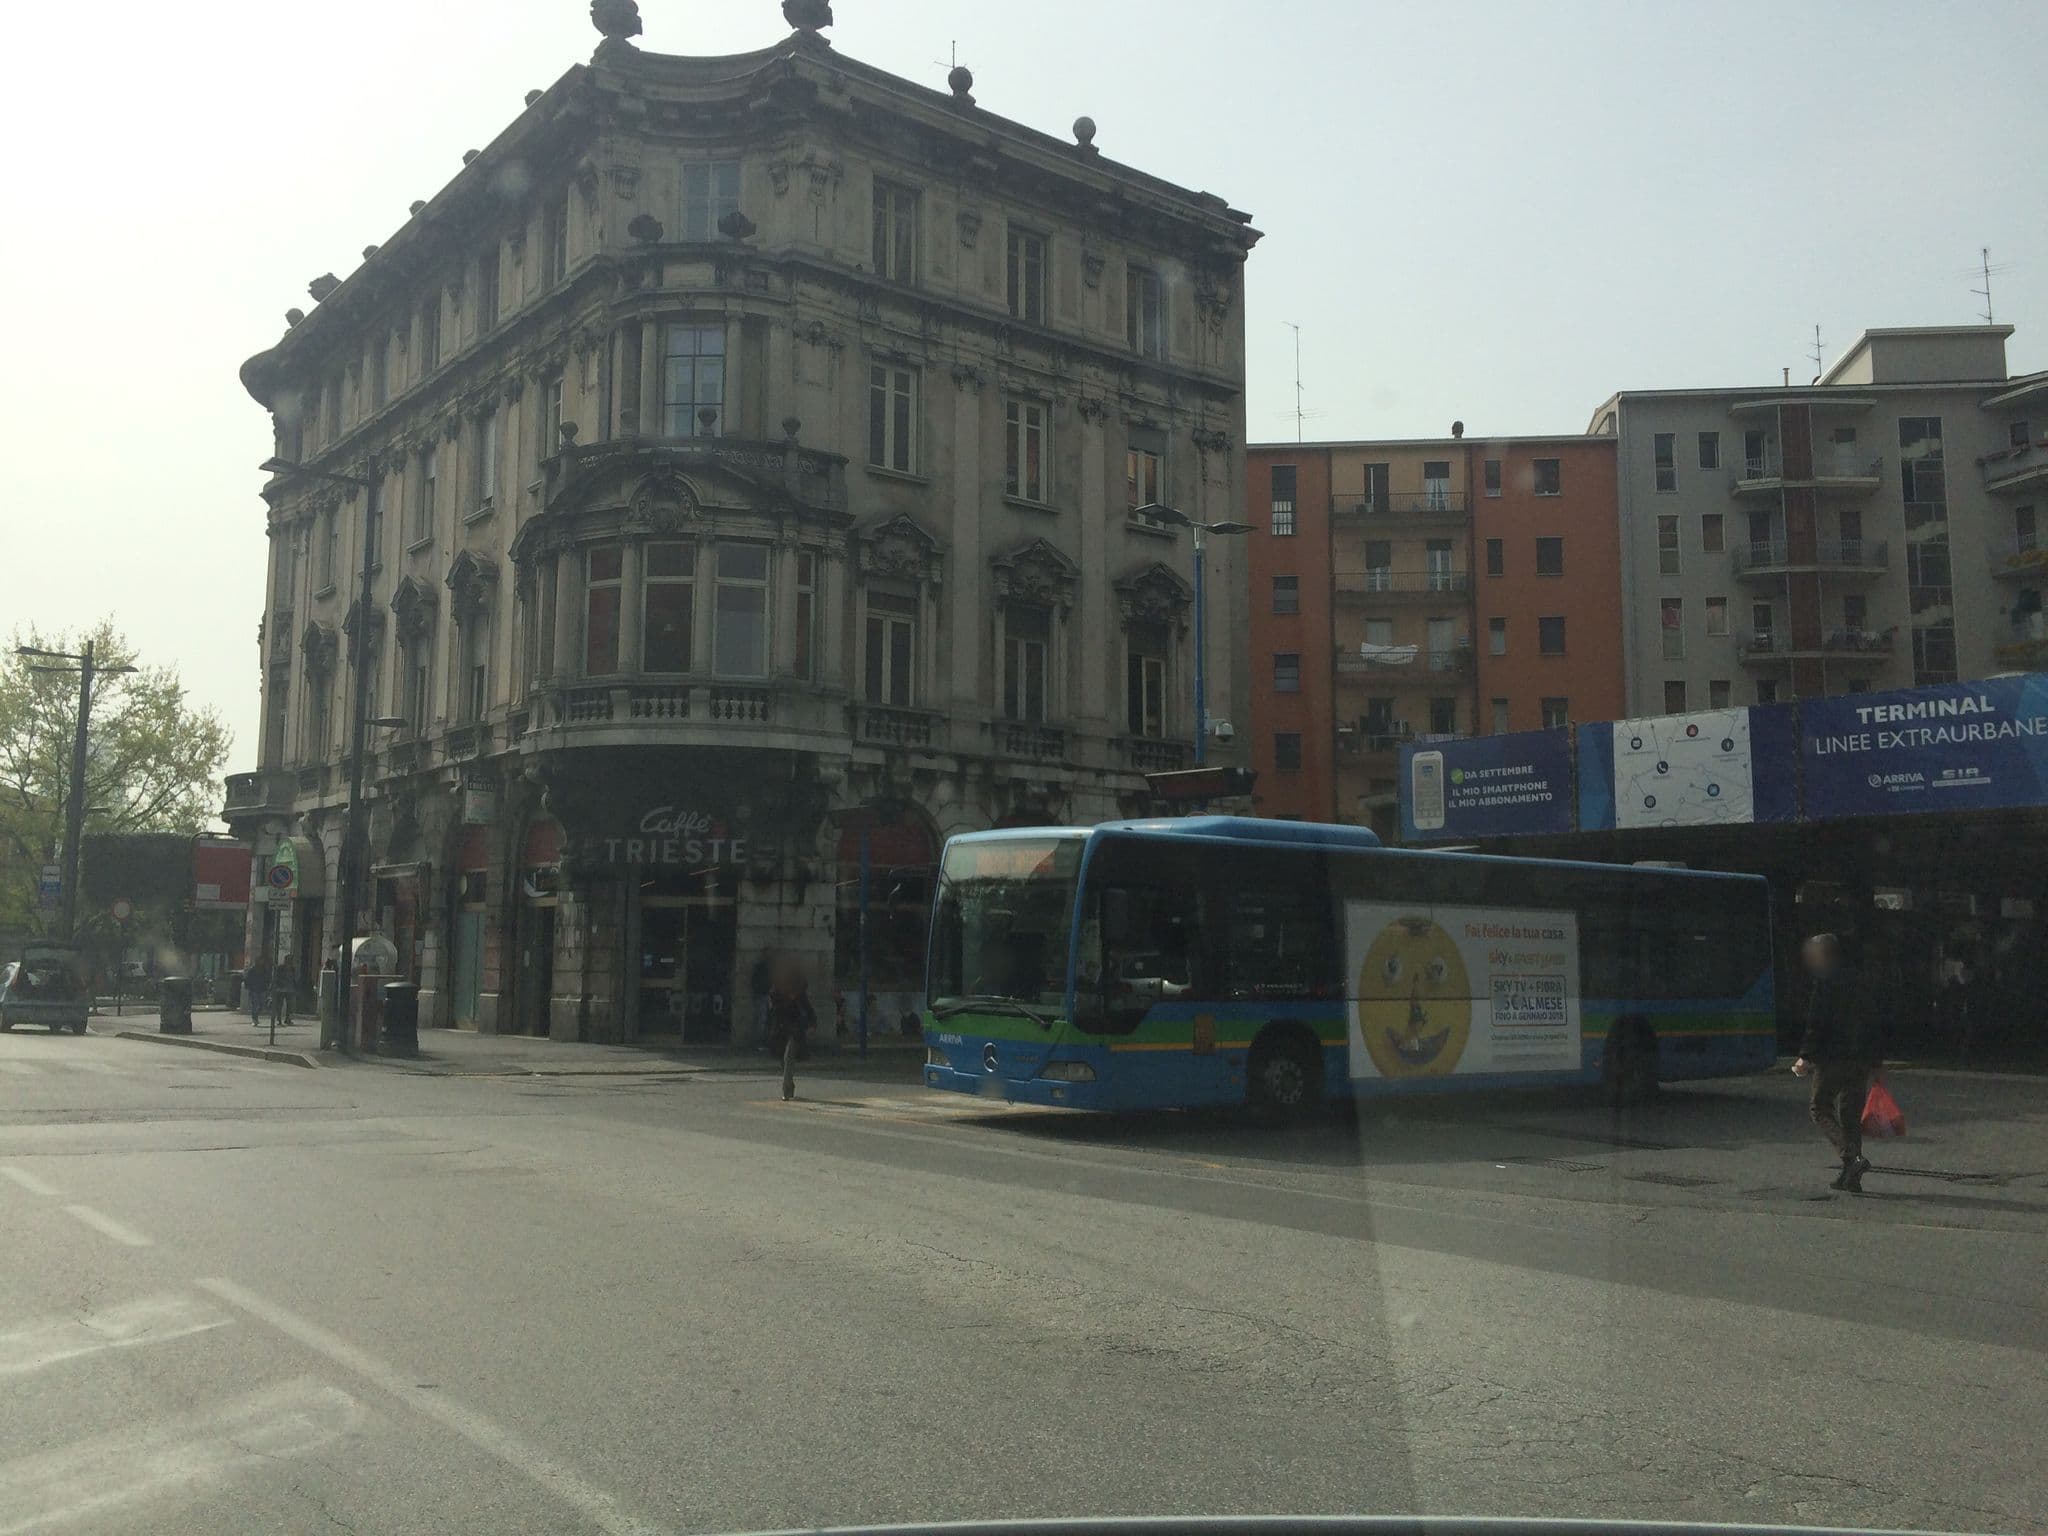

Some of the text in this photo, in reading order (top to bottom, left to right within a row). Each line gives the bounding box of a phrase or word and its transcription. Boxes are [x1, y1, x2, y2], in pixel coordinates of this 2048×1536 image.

[1856, 696, 1996, 724] TERMINAL
[1816, 717, 2048, 755] LINEE EXTRAURBANE
[1464, 764, 1534, 780] DA SETTEMBRE
[1883, 772, 1925, 785] ARRIVA
[1452, 780, 1548, 797] IL MIO SMARTPHONE
[1448, 793, 1553, 808] IL MIO ABBONAMENTO
[640, 806, 713, 838] Caffè
[604, 838, 748, 864] TRIESTE
[1482, 922, 1510, 938] felice
[1512, 924, 1521, 938] la
[1523, 926, 1540, 939] tua
[1514, 980, 1526, 993] TV
[1521, 996, 1535, 1010] AL
[1536, 996, 1563, 1010] MESE
